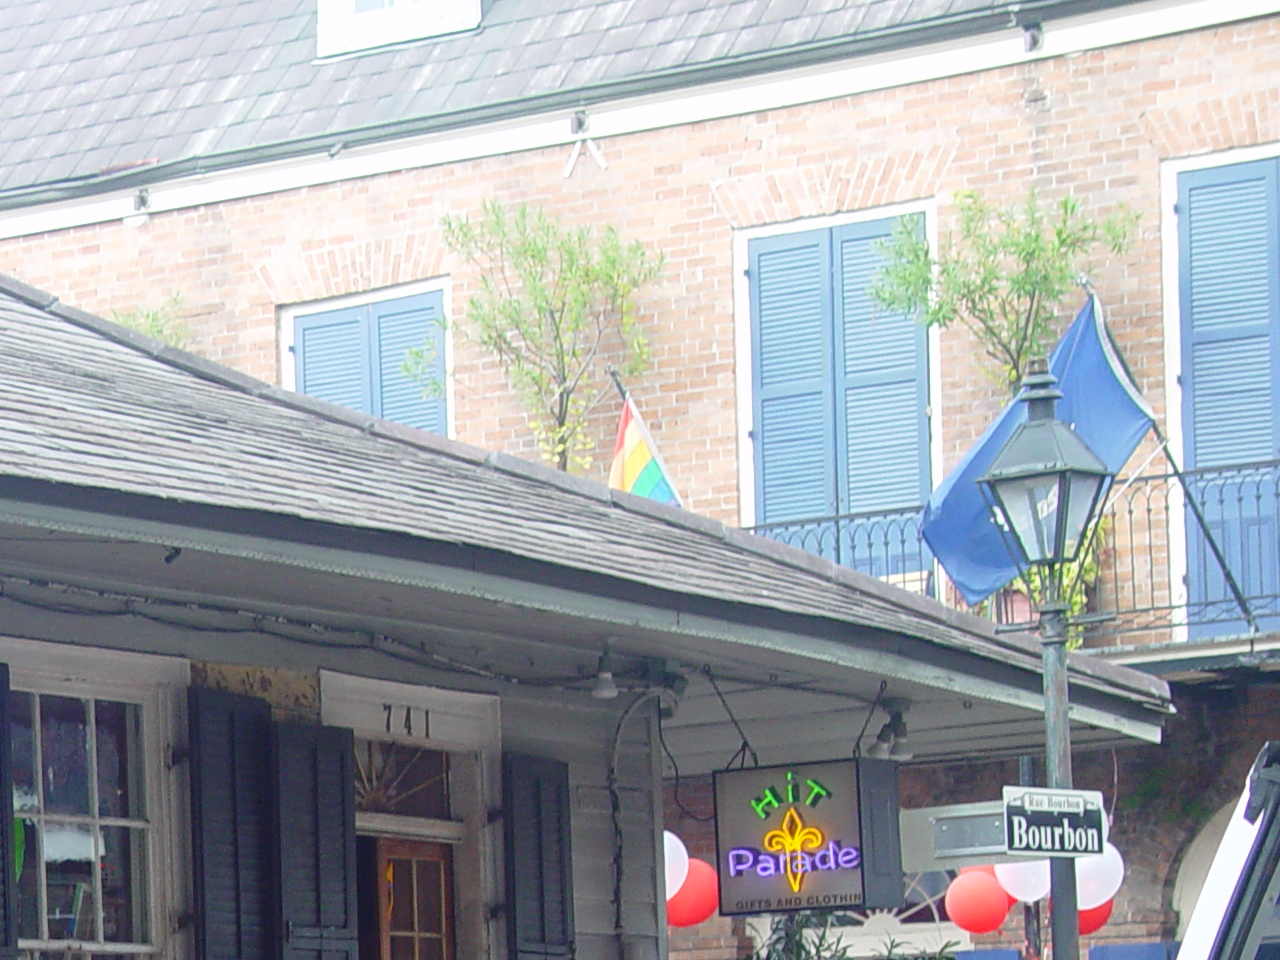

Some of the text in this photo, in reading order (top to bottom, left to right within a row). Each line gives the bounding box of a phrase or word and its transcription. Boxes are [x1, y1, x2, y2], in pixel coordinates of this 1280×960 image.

[383, 702, 430, 738] 741
[1011, 815, 1099, 851] Bourbon
[728, 840, 861, 878] Parade
[736, 897, 772, 909] GIFTS
[776, 897, 802, 908] AND
